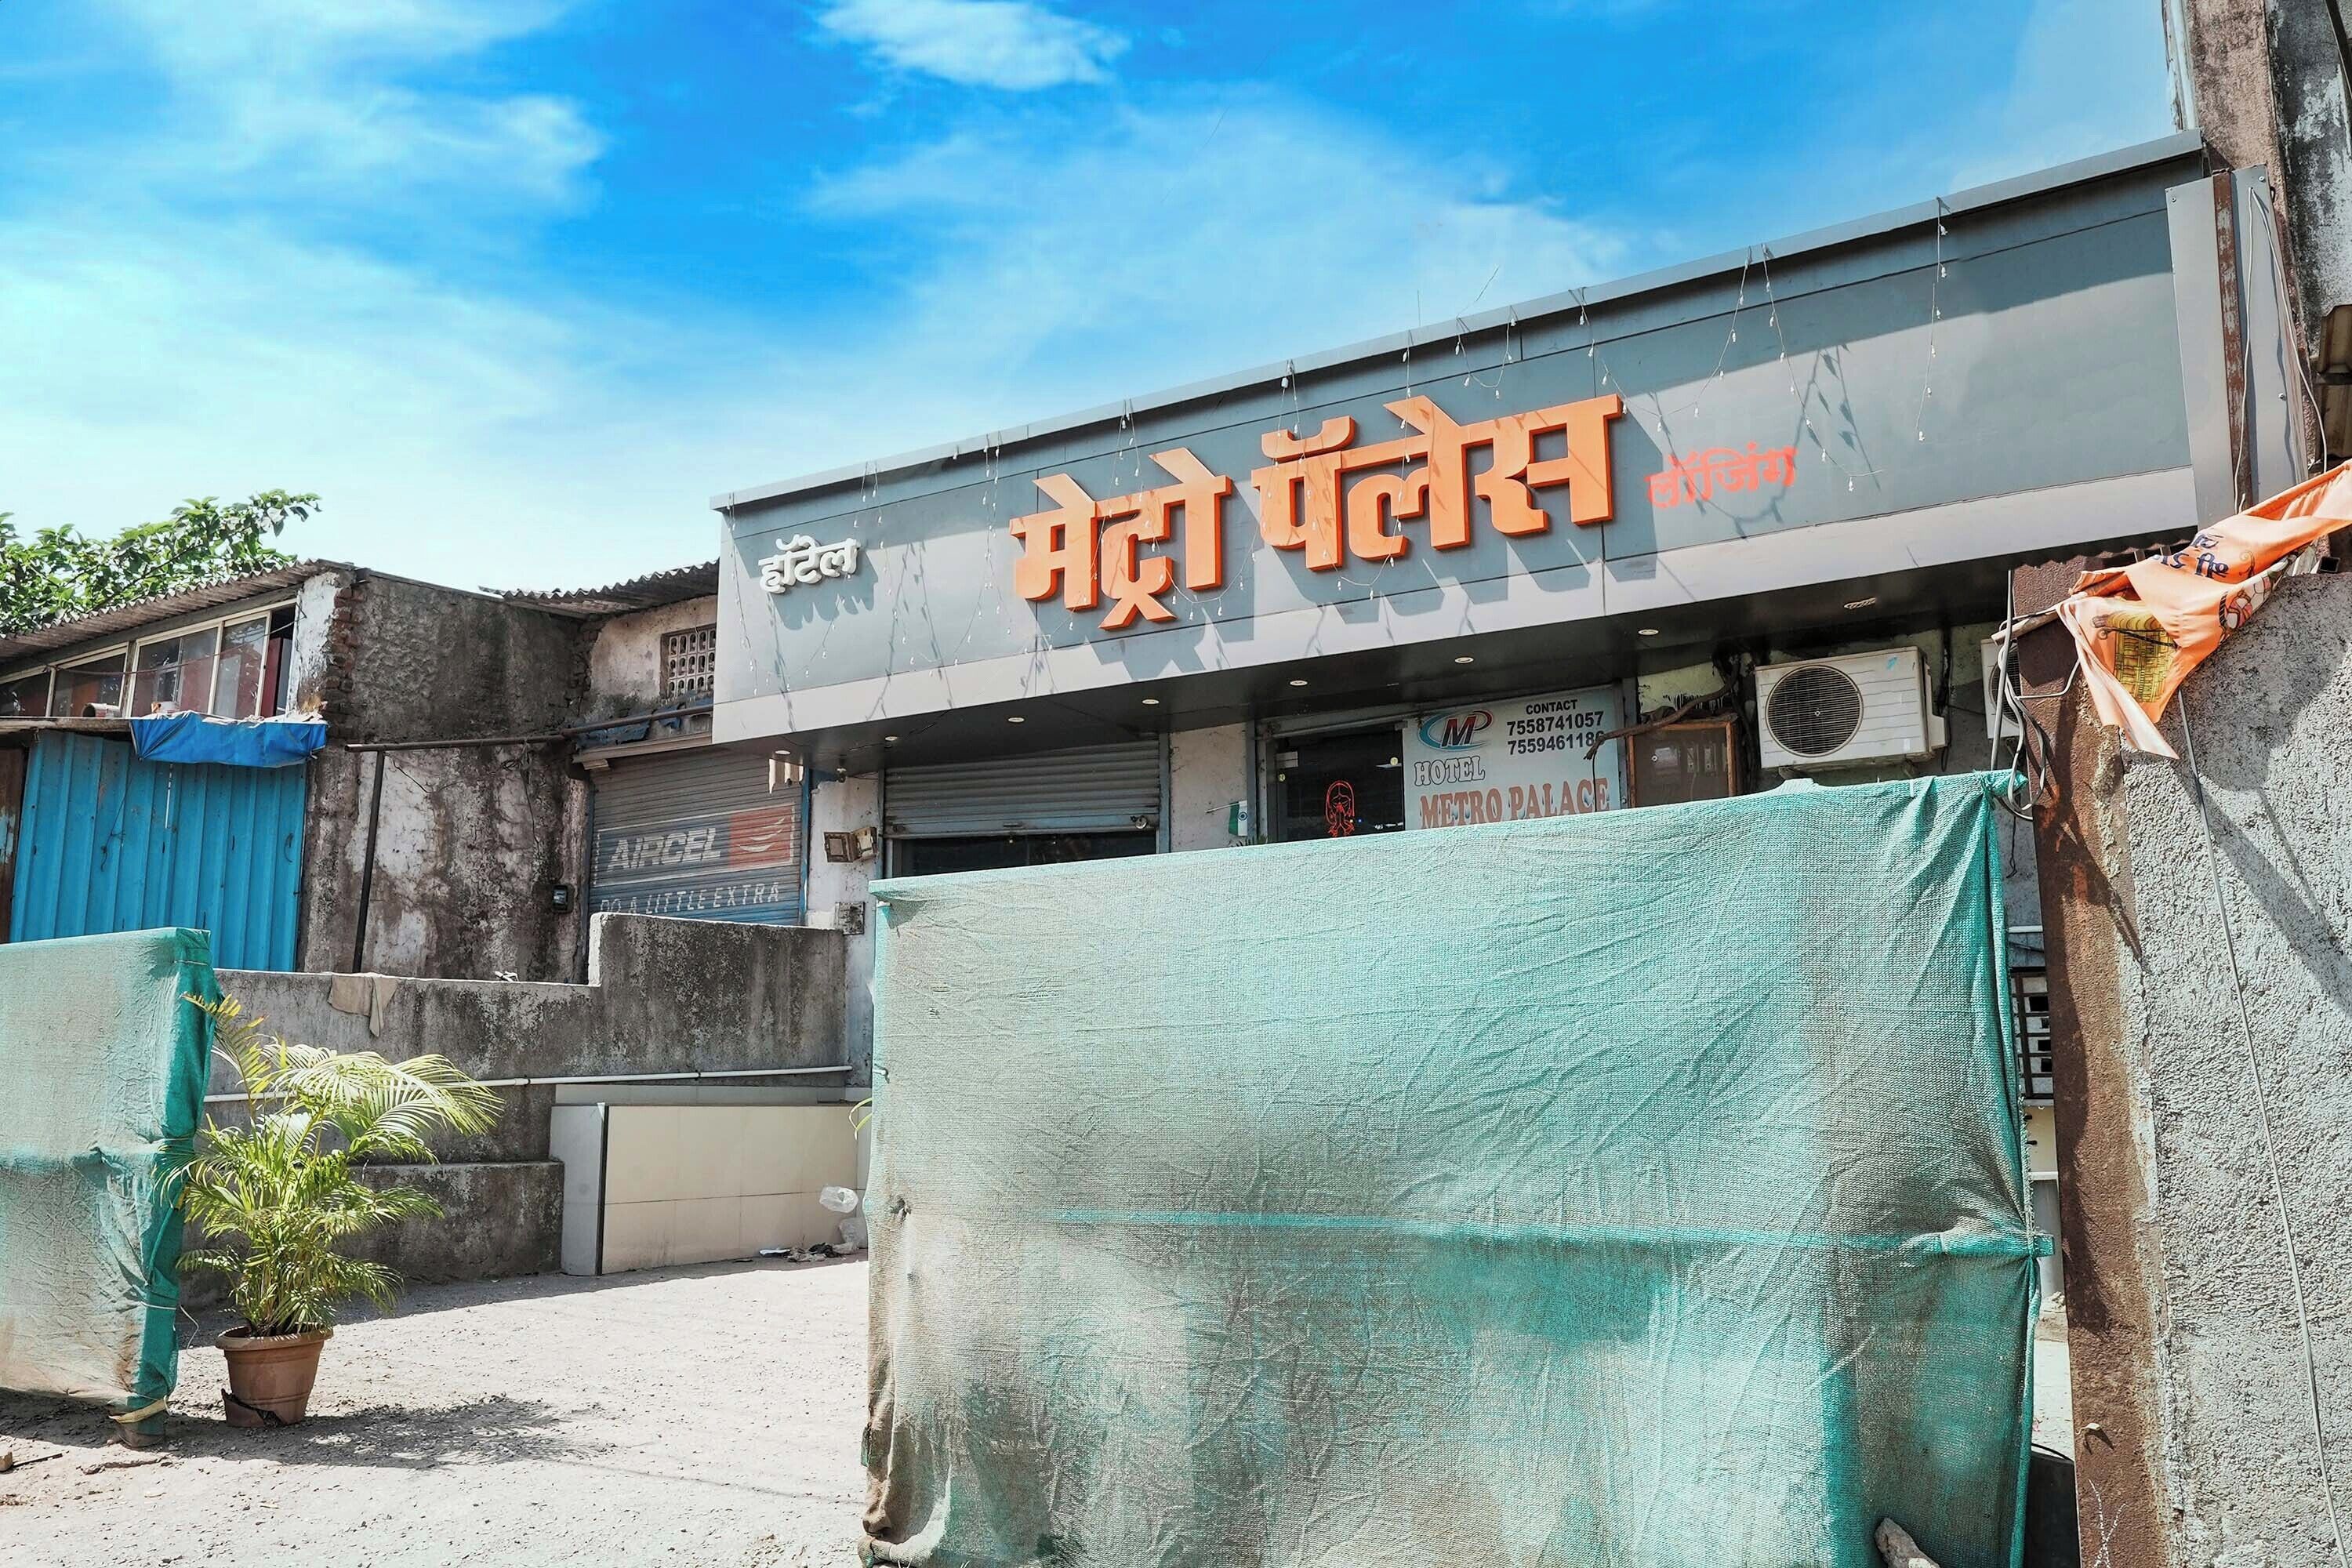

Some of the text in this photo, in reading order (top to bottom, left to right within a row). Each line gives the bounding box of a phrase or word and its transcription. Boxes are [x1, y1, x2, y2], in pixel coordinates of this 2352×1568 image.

[758, 534, 861, 593] हॉटेल
[1009, 448, 1232, 630] मेट्रो
[1252, 394, 1622, 572] पॅलेस
[1507, 710, 1604, 736] 7558741057
[1526, 699, 1577, 715] CONTACT
[1414, 755, 1486, 786] HOTEL
[1420, 778, 1610, 829] METRO PALACE
[607, 828, 721, 873] AIRCEL
[628, 897, 637, 914] A
[645, 890, 707, 914] LITTLE
[713, 882, 780, 909] EXTRA
